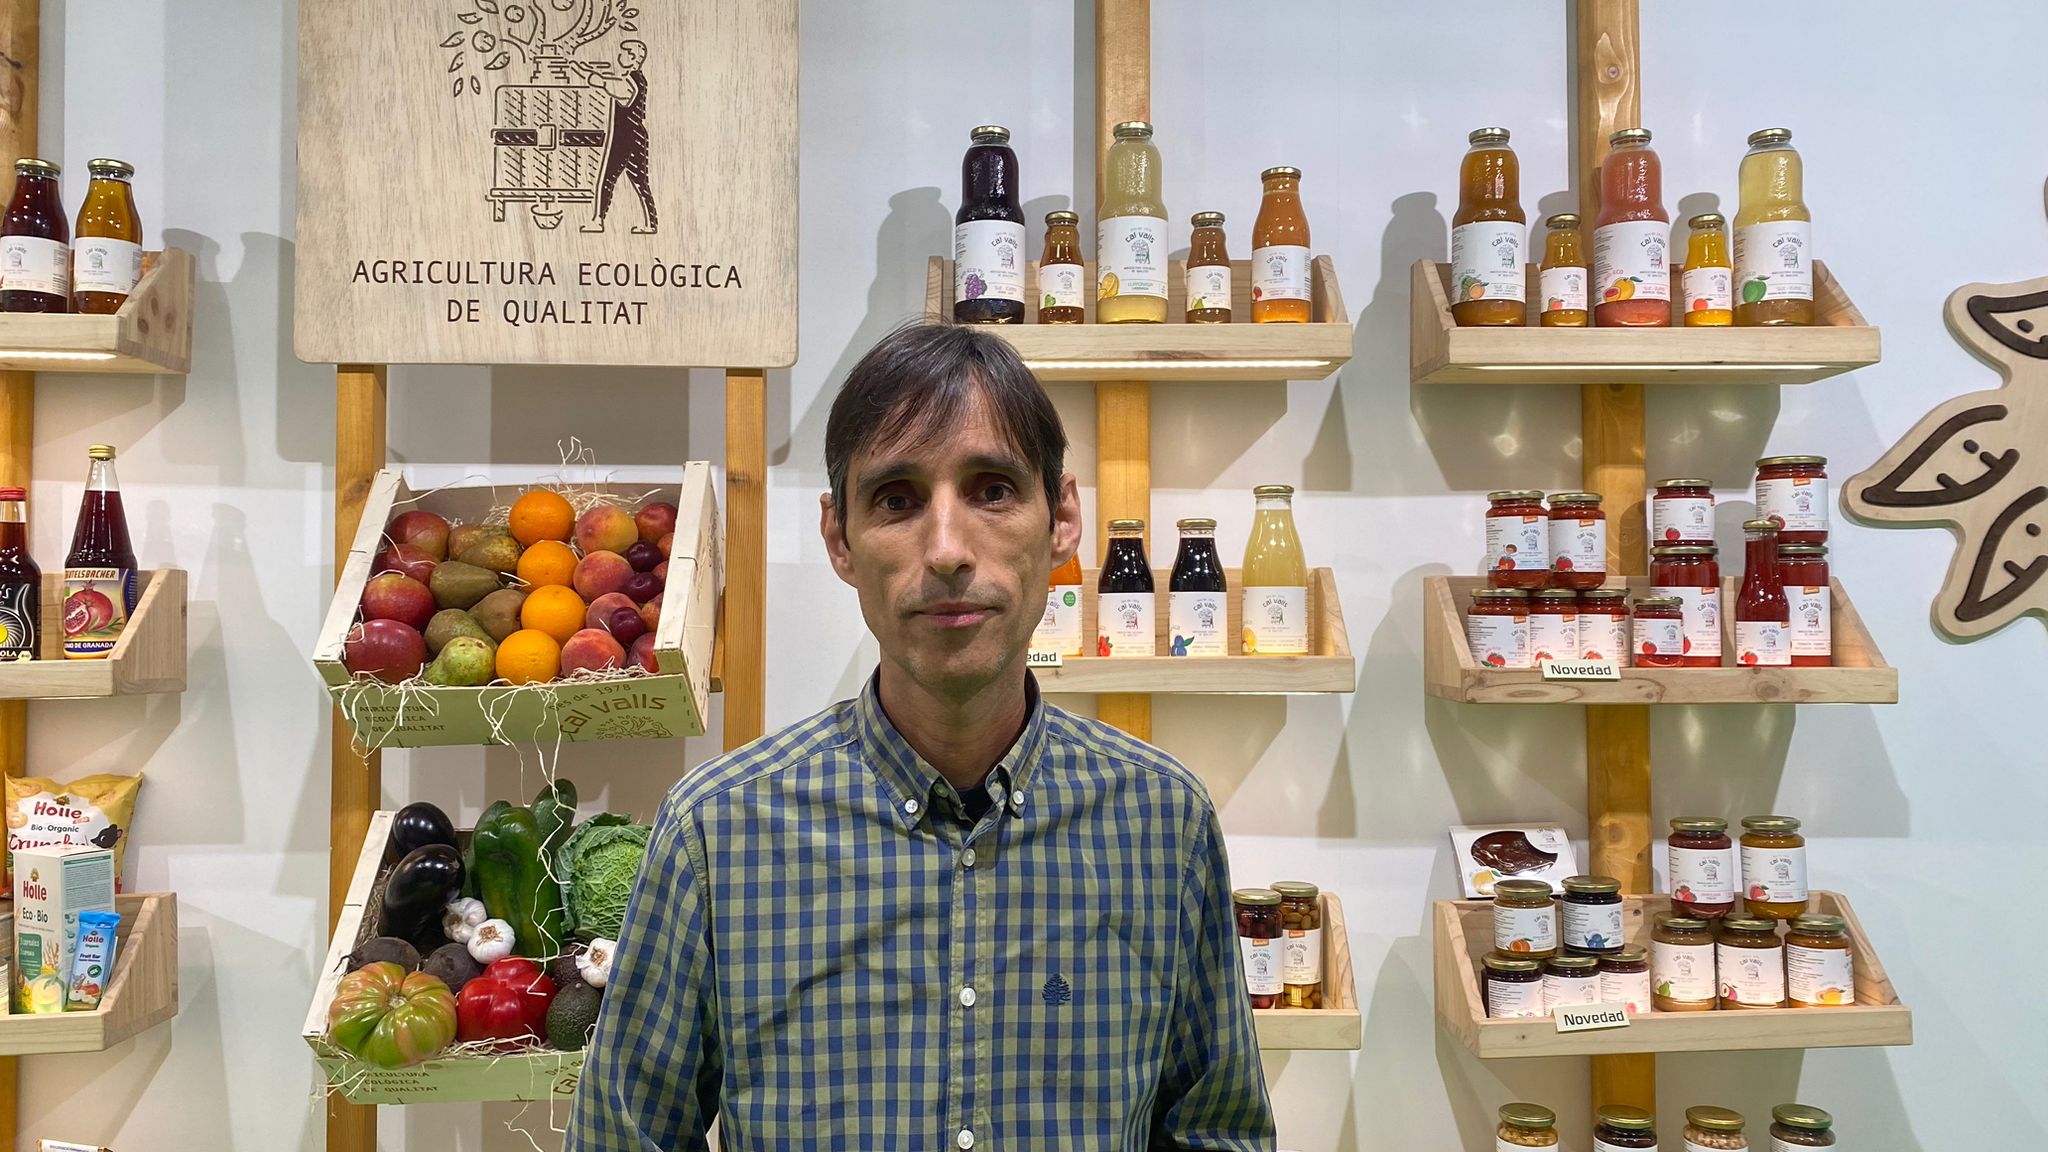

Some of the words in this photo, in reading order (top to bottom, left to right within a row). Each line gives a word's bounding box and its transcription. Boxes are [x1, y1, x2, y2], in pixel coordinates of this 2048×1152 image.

[352, 260, 556, 286] AGRICULTURA
[578, 257, 742, 289] ECOLÒGICA
[447, 299, 480, 322] DE
[503, 300, 648, 327] QUALITAT
[1550, 664, 1612, 676] Novedad
[596, 684, 631, 694] 1978
[34, 801, 82, 819] Holle
[23, 881, 47, 900] Holle
[23, 908, 32, 920] Eco
[37, 910, 48, 922] Bio
[1564, 1011, 1625, 1026] Novedad
